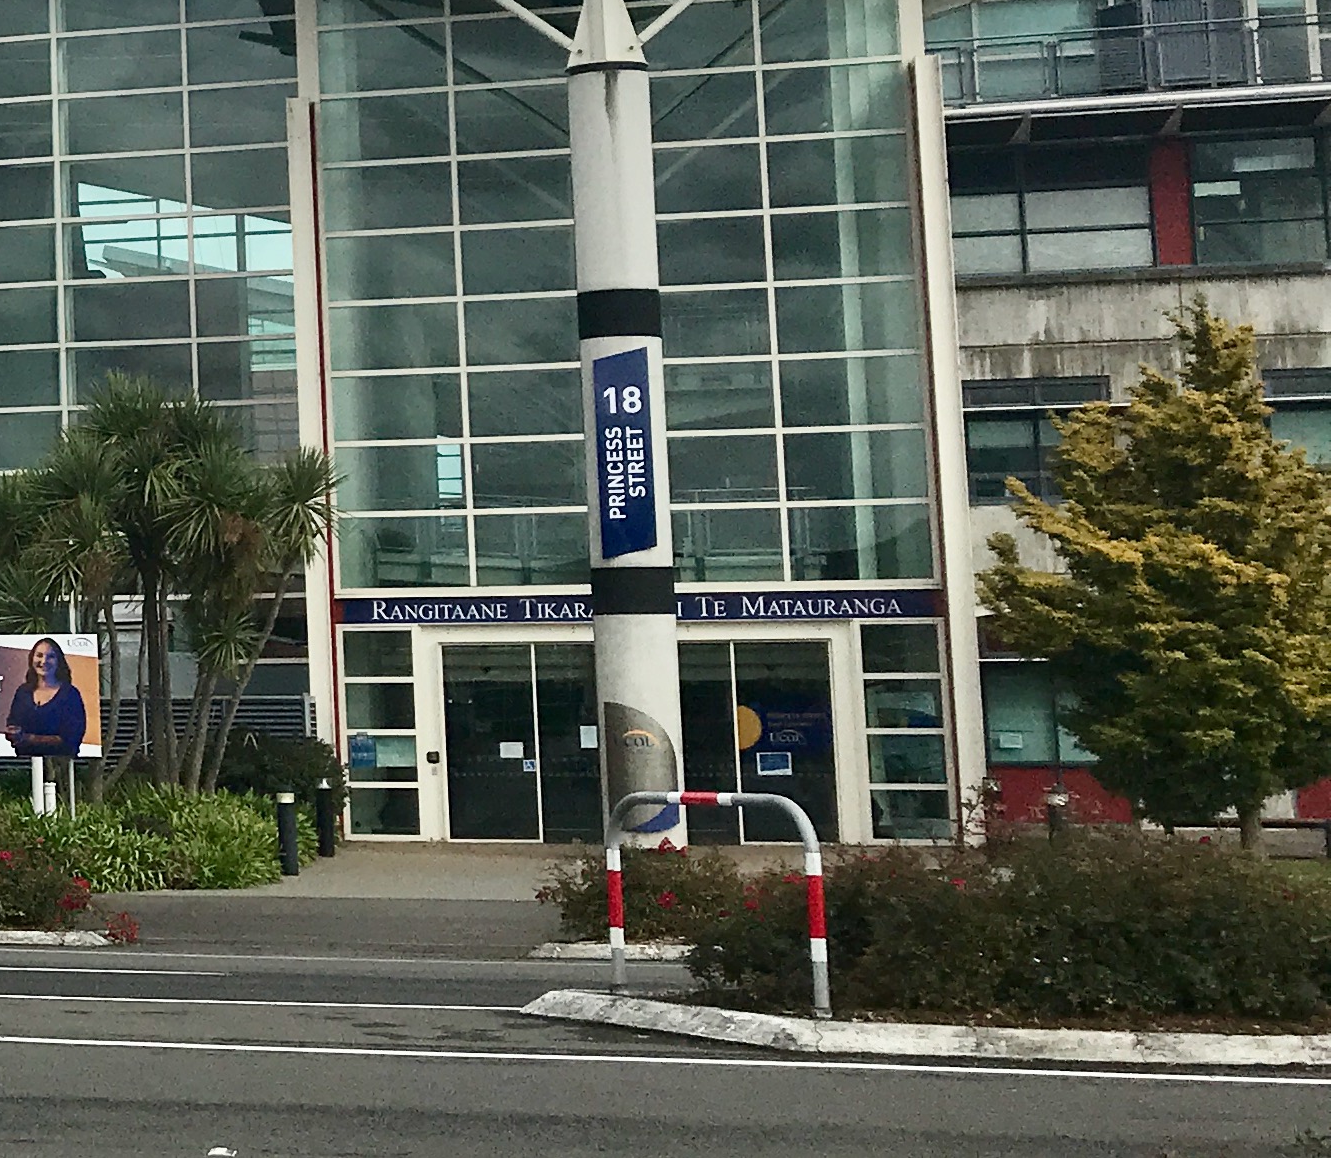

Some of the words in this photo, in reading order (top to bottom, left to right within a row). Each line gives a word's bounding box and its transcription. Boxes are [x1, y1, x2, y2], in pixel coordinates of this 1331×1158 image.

[603, 385, 642, 414] 18
[605, 426, 626, 520] PRINCESS
[626, 425, 646, 498] STREET
